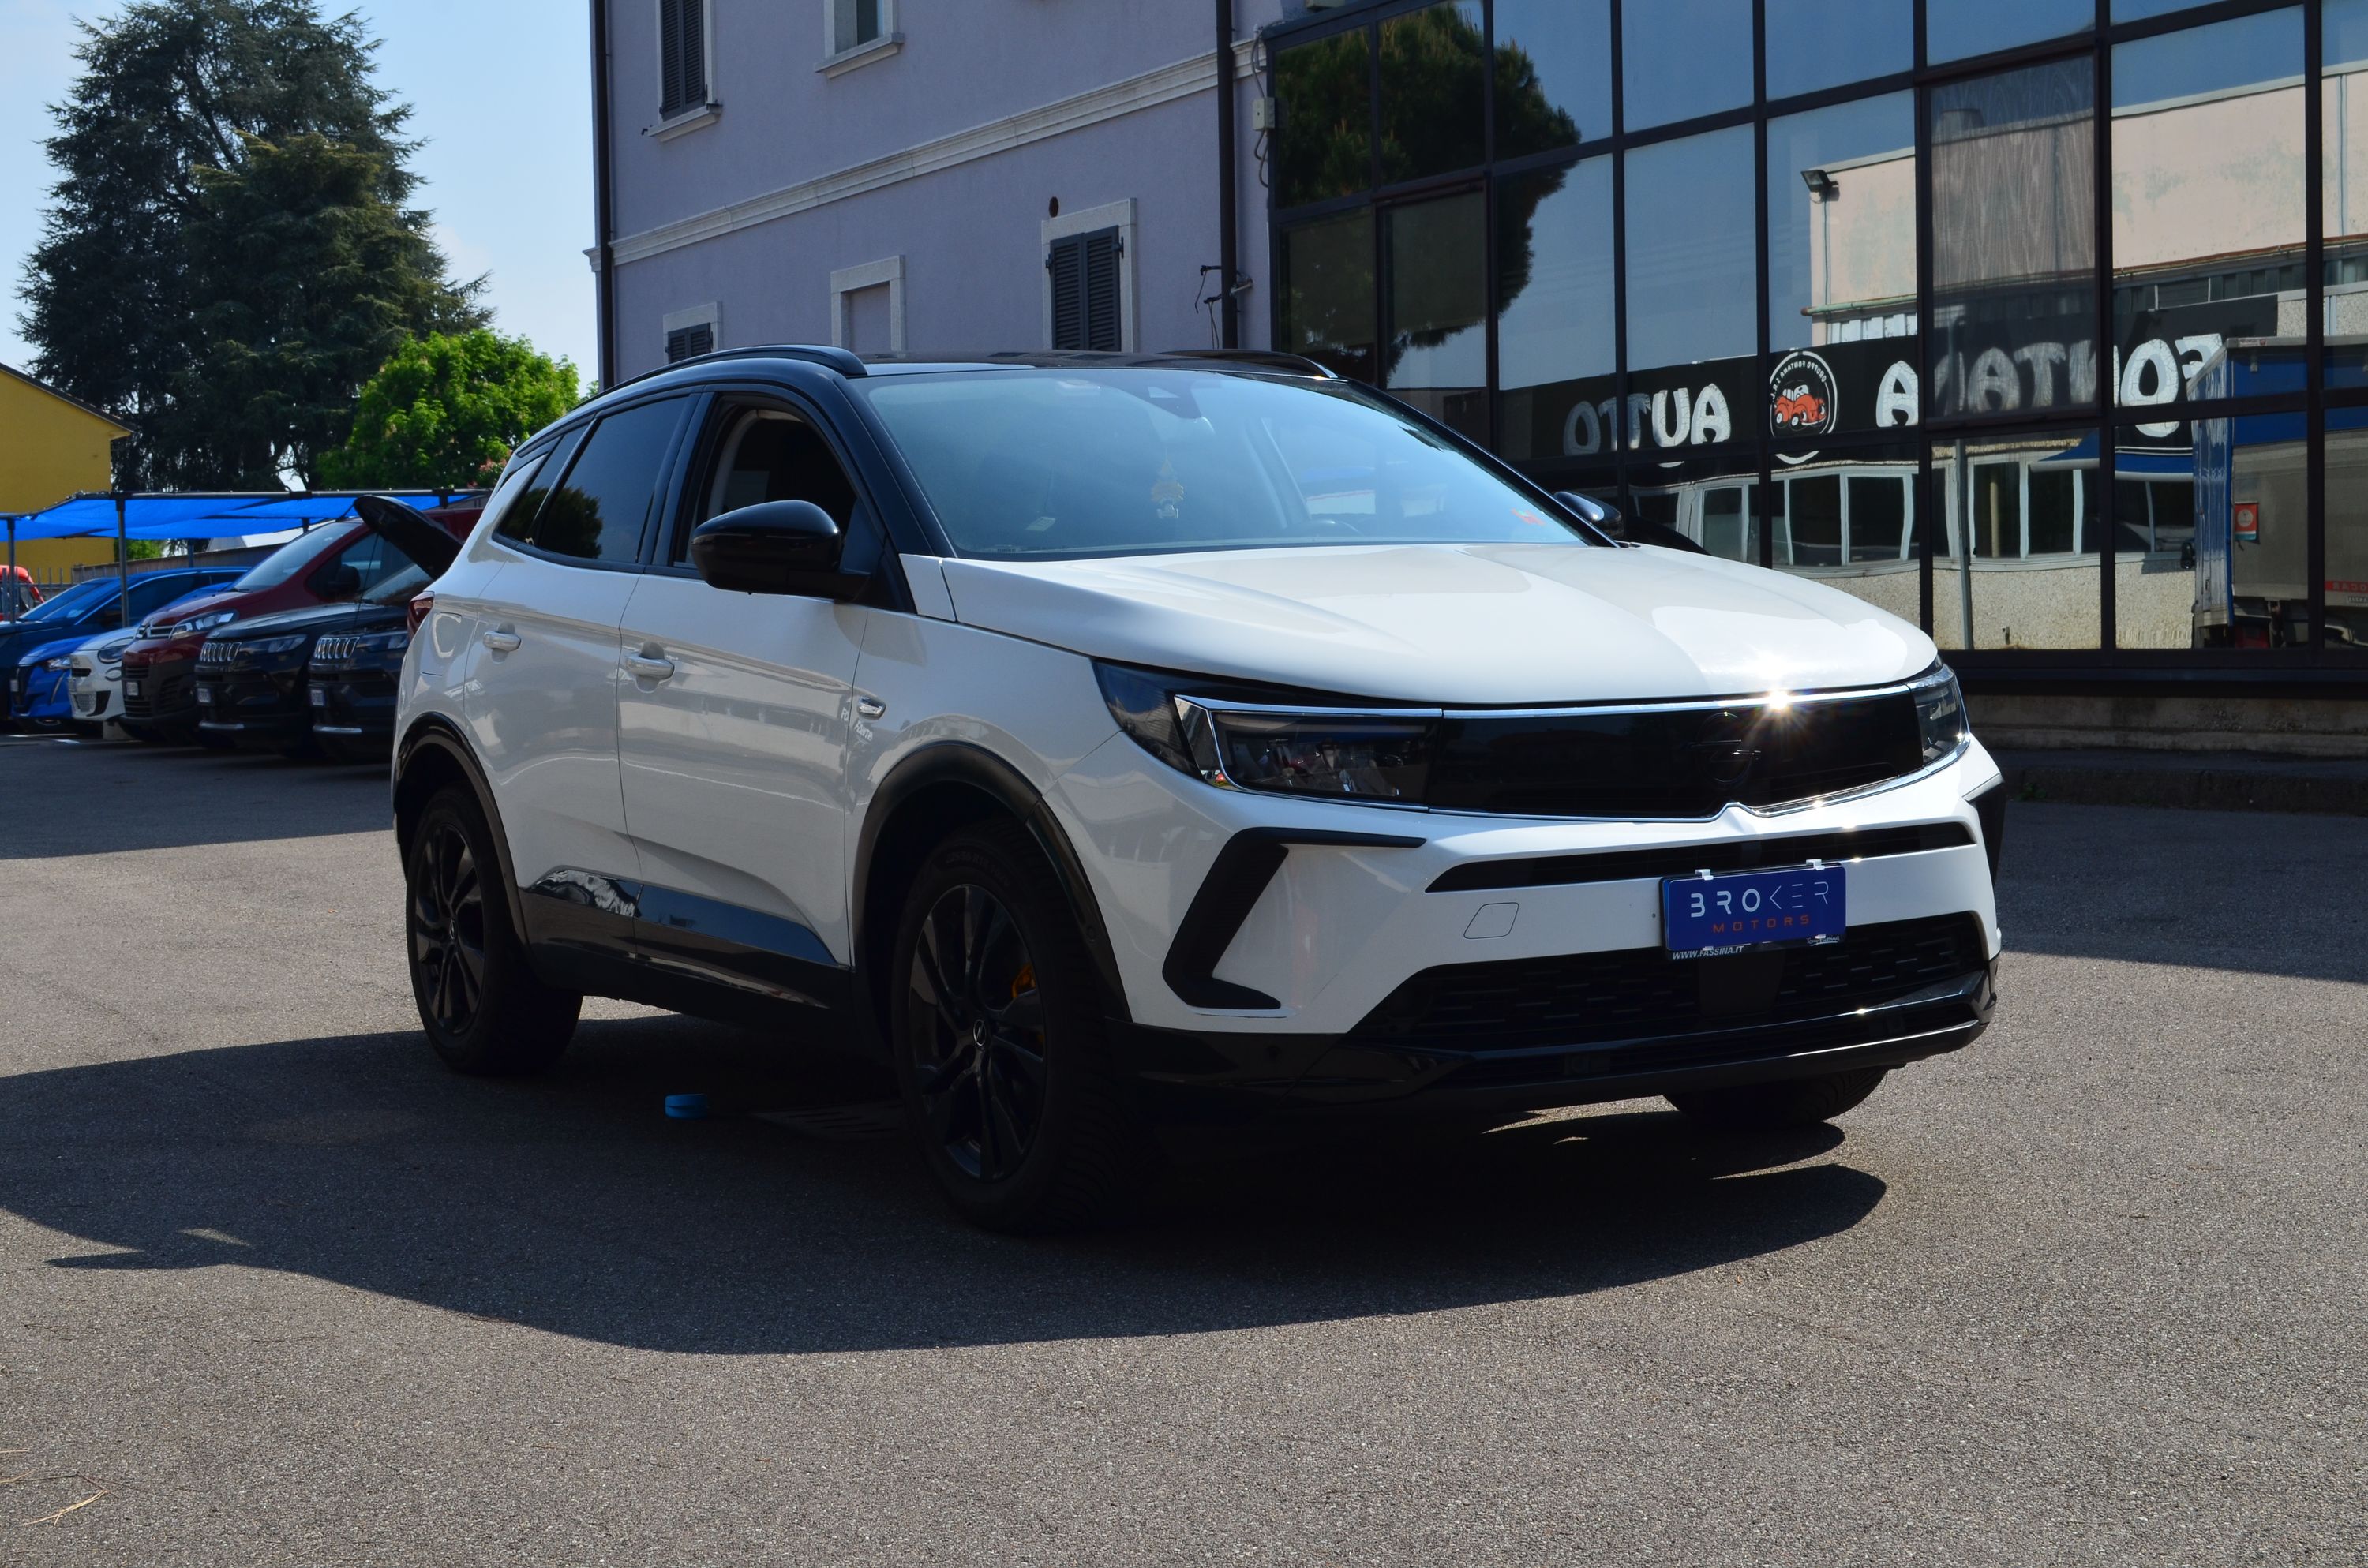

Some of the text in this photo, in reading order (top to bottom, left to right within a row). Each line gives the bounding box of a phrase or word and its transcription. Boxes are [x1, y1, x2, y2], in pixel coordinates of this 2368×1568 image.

[1690, 881, 1829, 918] BROKER
[1713, 915, 1810, 933] MOTORS
[1673, 945, 1744, 960] WWW.FASSINA.IT
